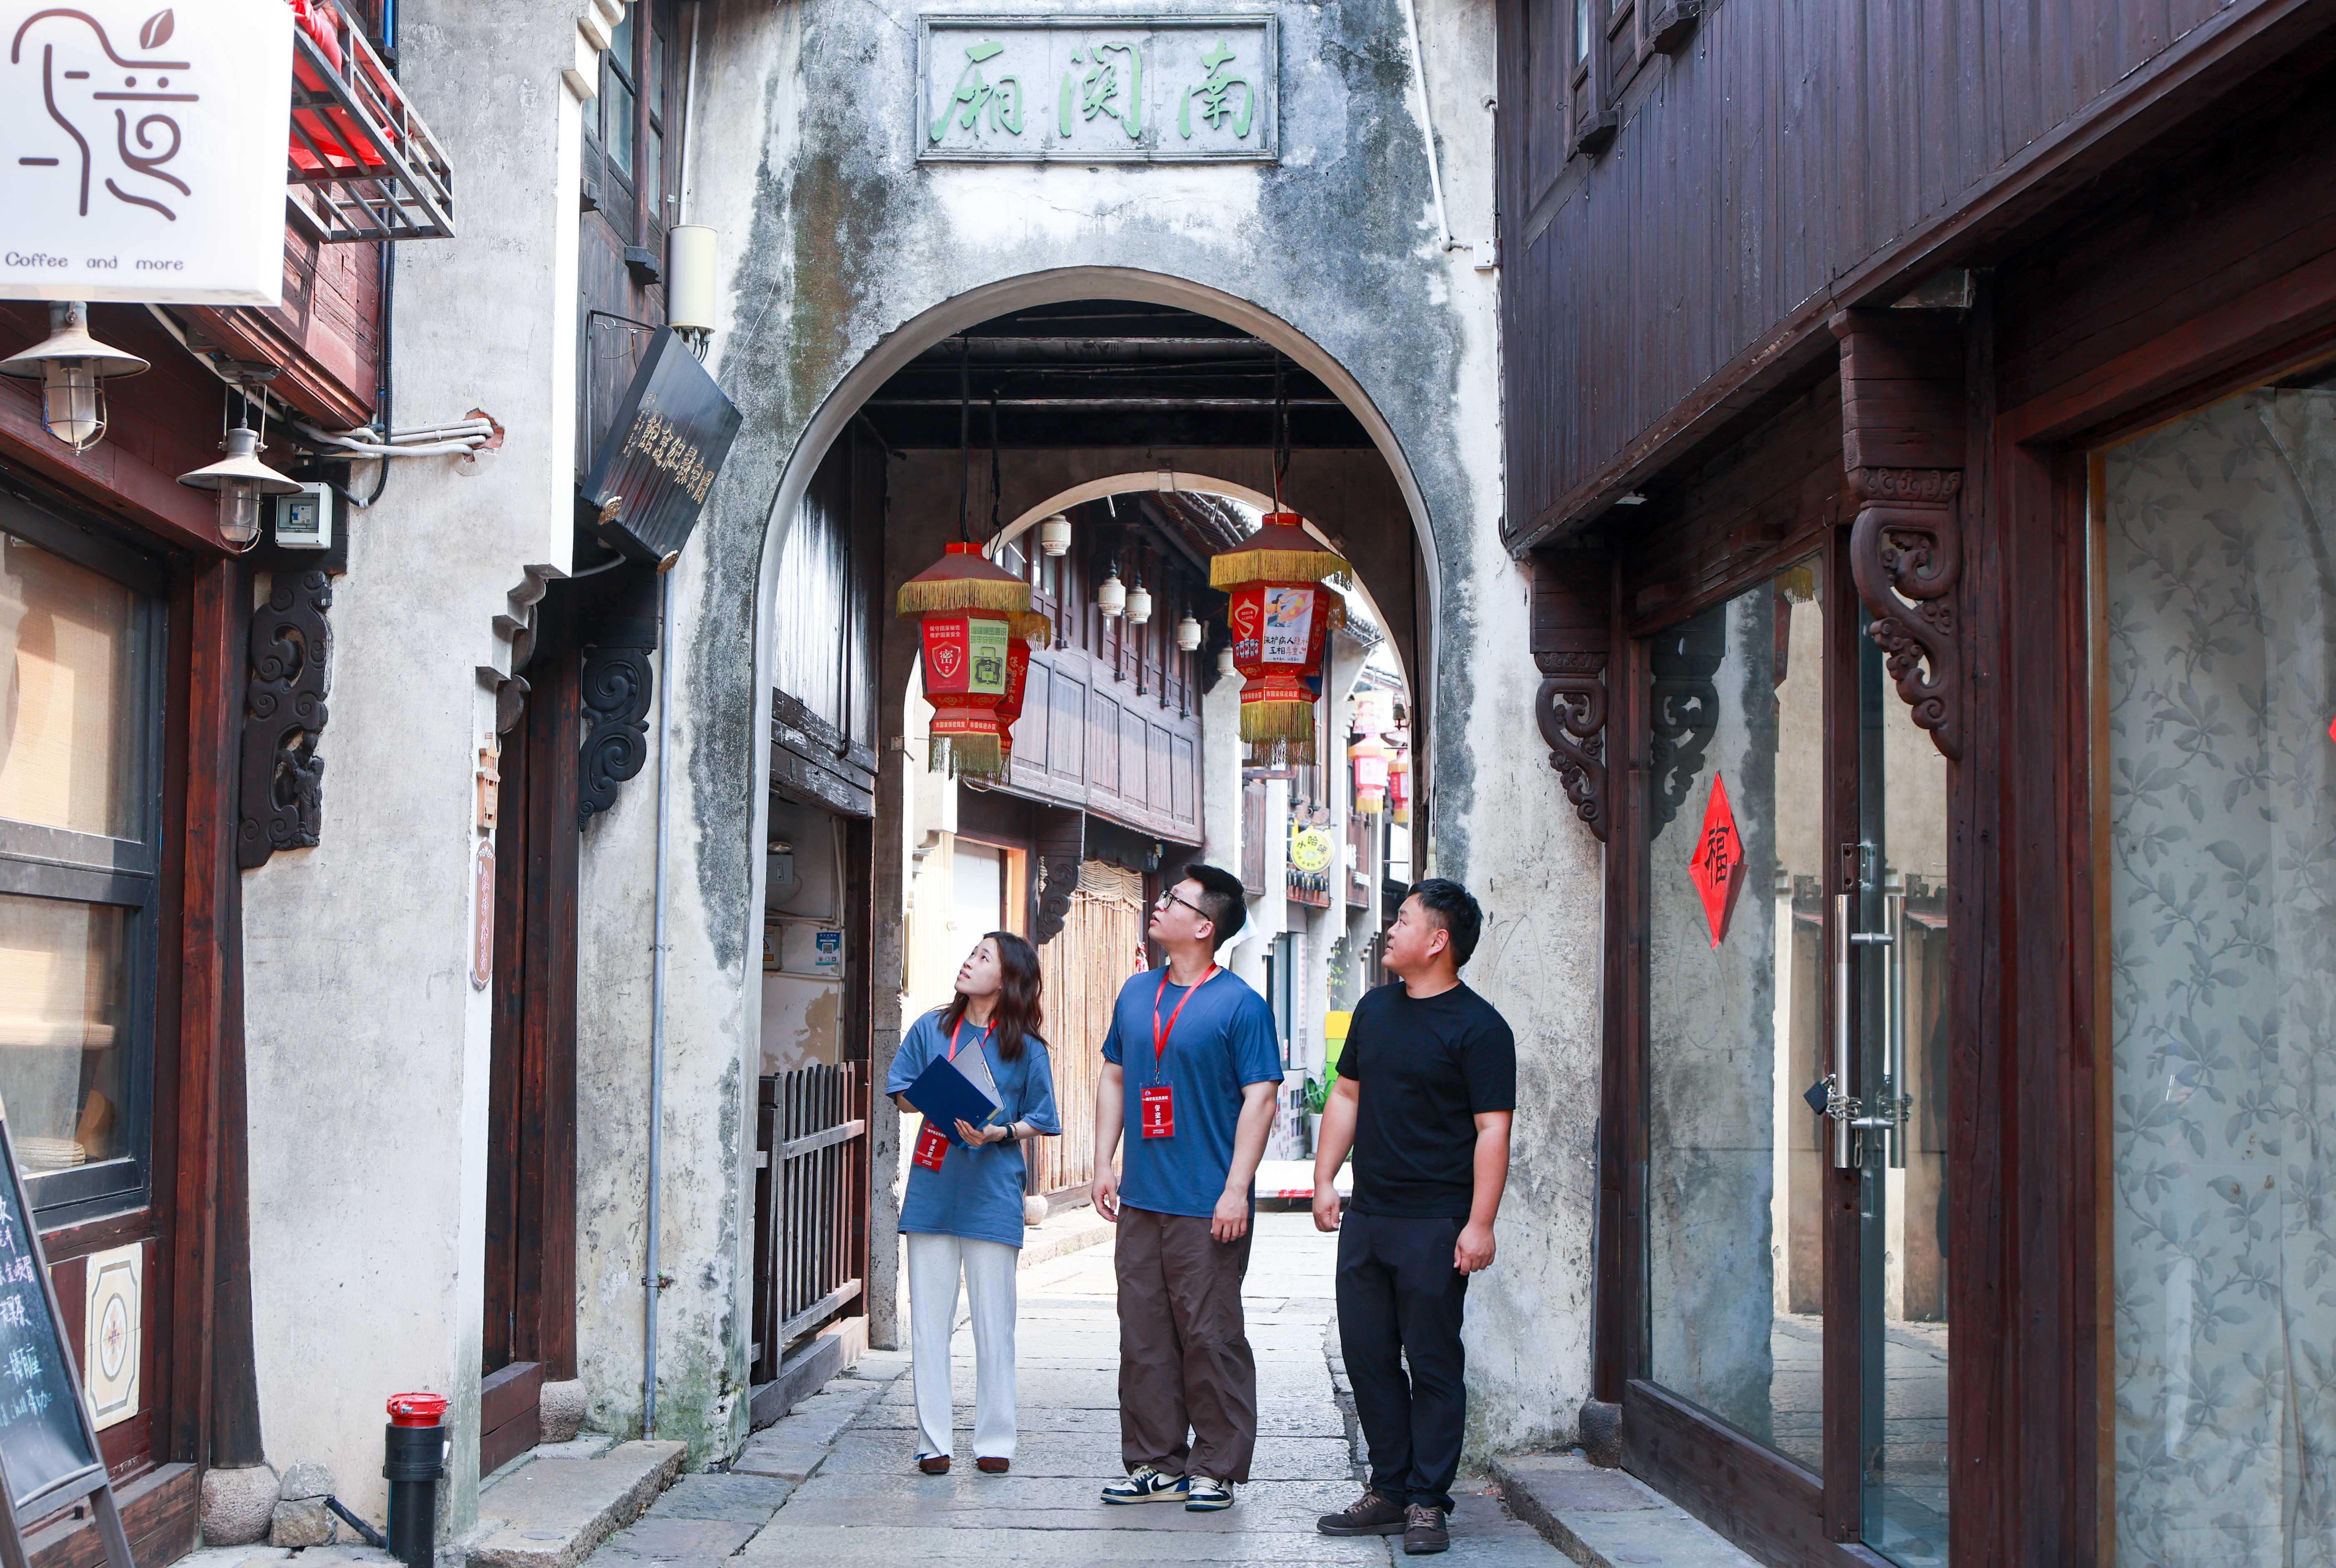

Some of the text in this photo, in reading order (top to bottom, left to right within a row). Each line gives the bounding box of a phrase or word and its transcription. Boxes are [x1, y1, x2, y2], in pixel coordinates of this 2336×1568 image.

[5, 251, 184, 271] Coffee and more
[939, 649, 953, 664] 密
[1269, 646, 1298, 655] 互相尊重
[1704, 818, 1730, 890] 福
